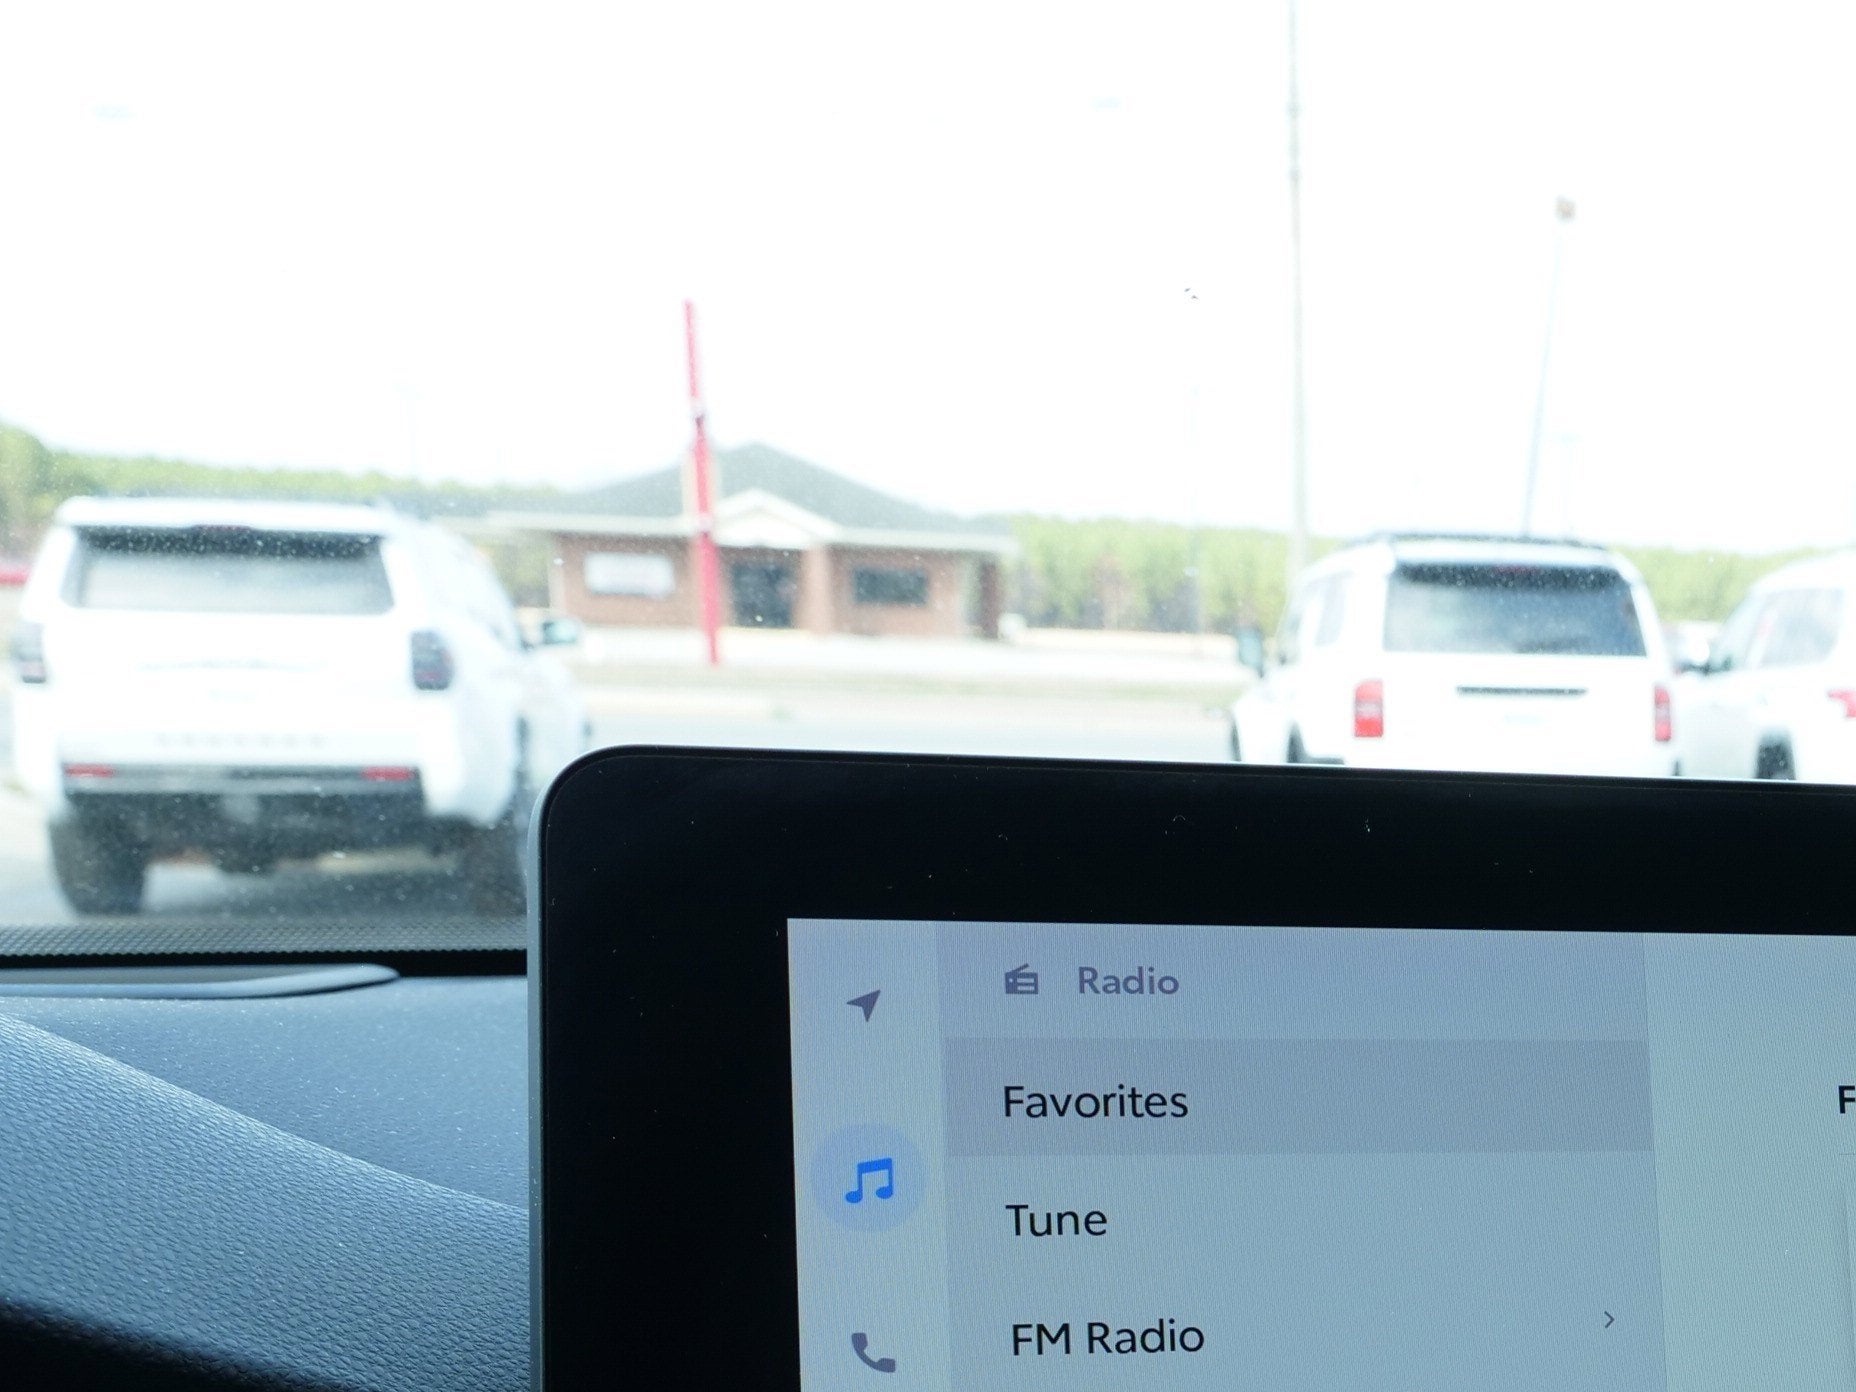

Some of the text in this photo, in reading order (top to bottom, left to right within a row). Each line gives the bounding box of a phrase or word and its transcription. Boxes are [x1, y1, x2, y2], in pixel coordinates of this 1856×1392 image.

[1077, 965, 1180, 996] Radio
[1003, 1083, 1189, 1119] Favorites
[1005, 1203, 1108, 1237] Tune
[1011, 1318, 1206, 1356] FM Radio
